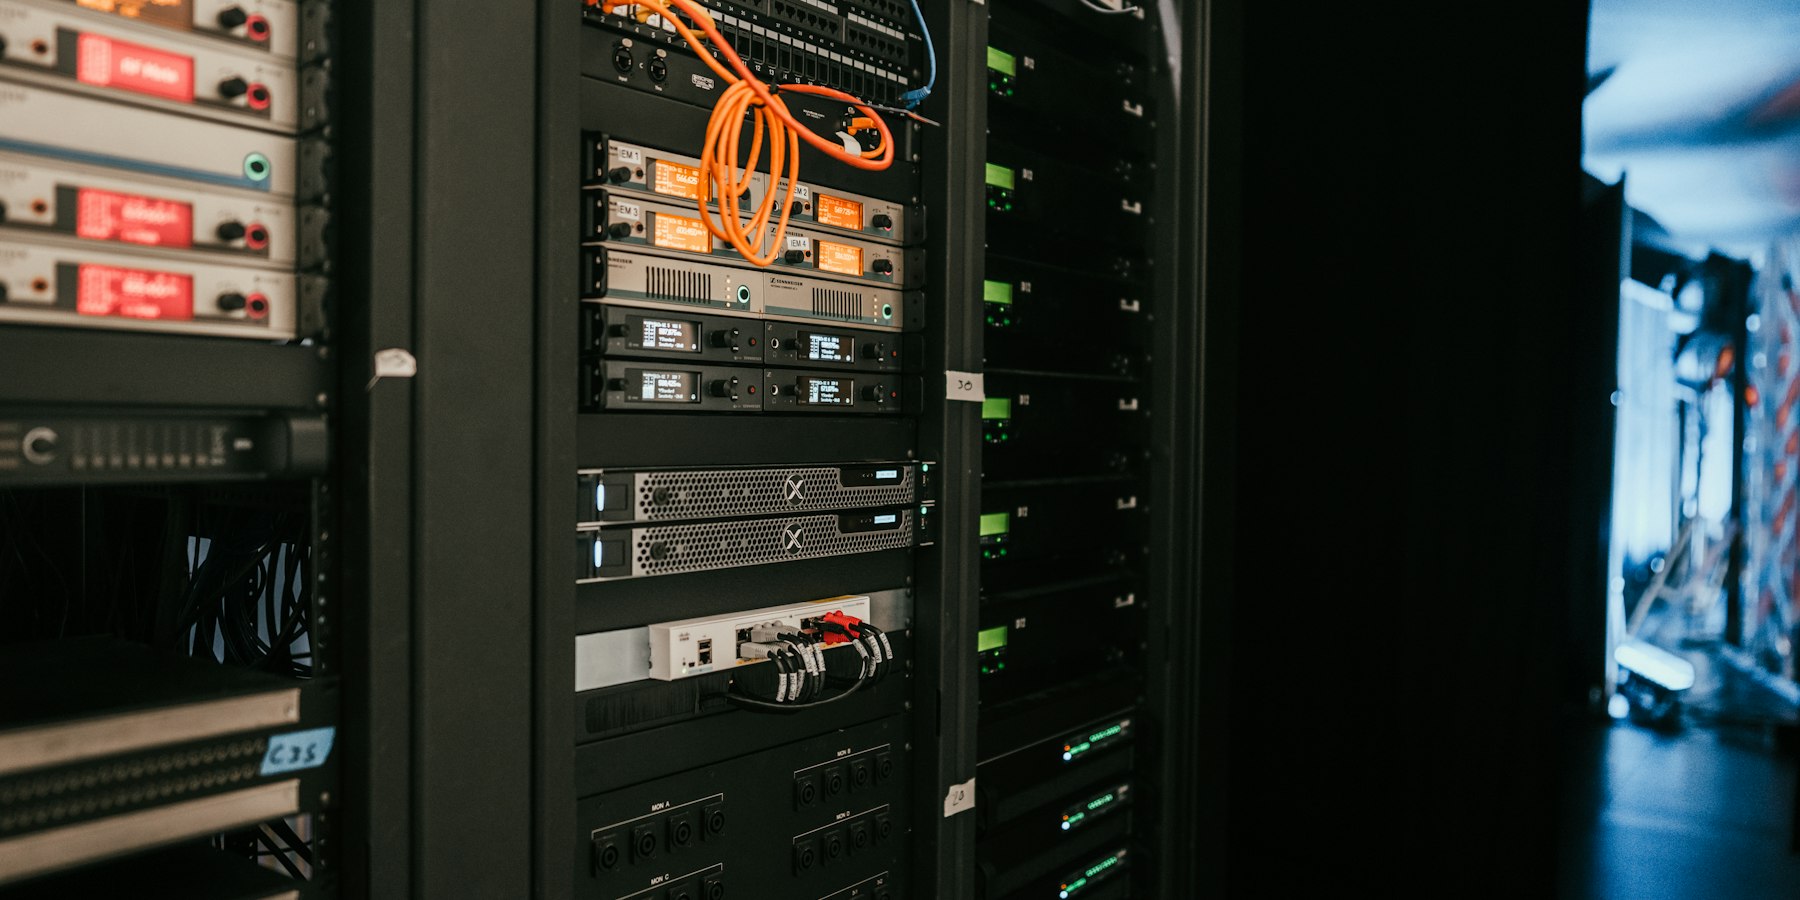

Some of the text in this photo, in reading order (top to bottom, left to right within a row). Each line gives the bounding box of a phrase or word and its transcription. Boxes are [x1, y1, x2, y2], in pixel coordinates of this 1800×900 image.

[803, 188, 808, 197] 2
[633, 207, 638, 217] 3
[790, 239, 802, 247] IEM
[652, 802, 664, 812] MON
[650, 876, 664, 885] MON
